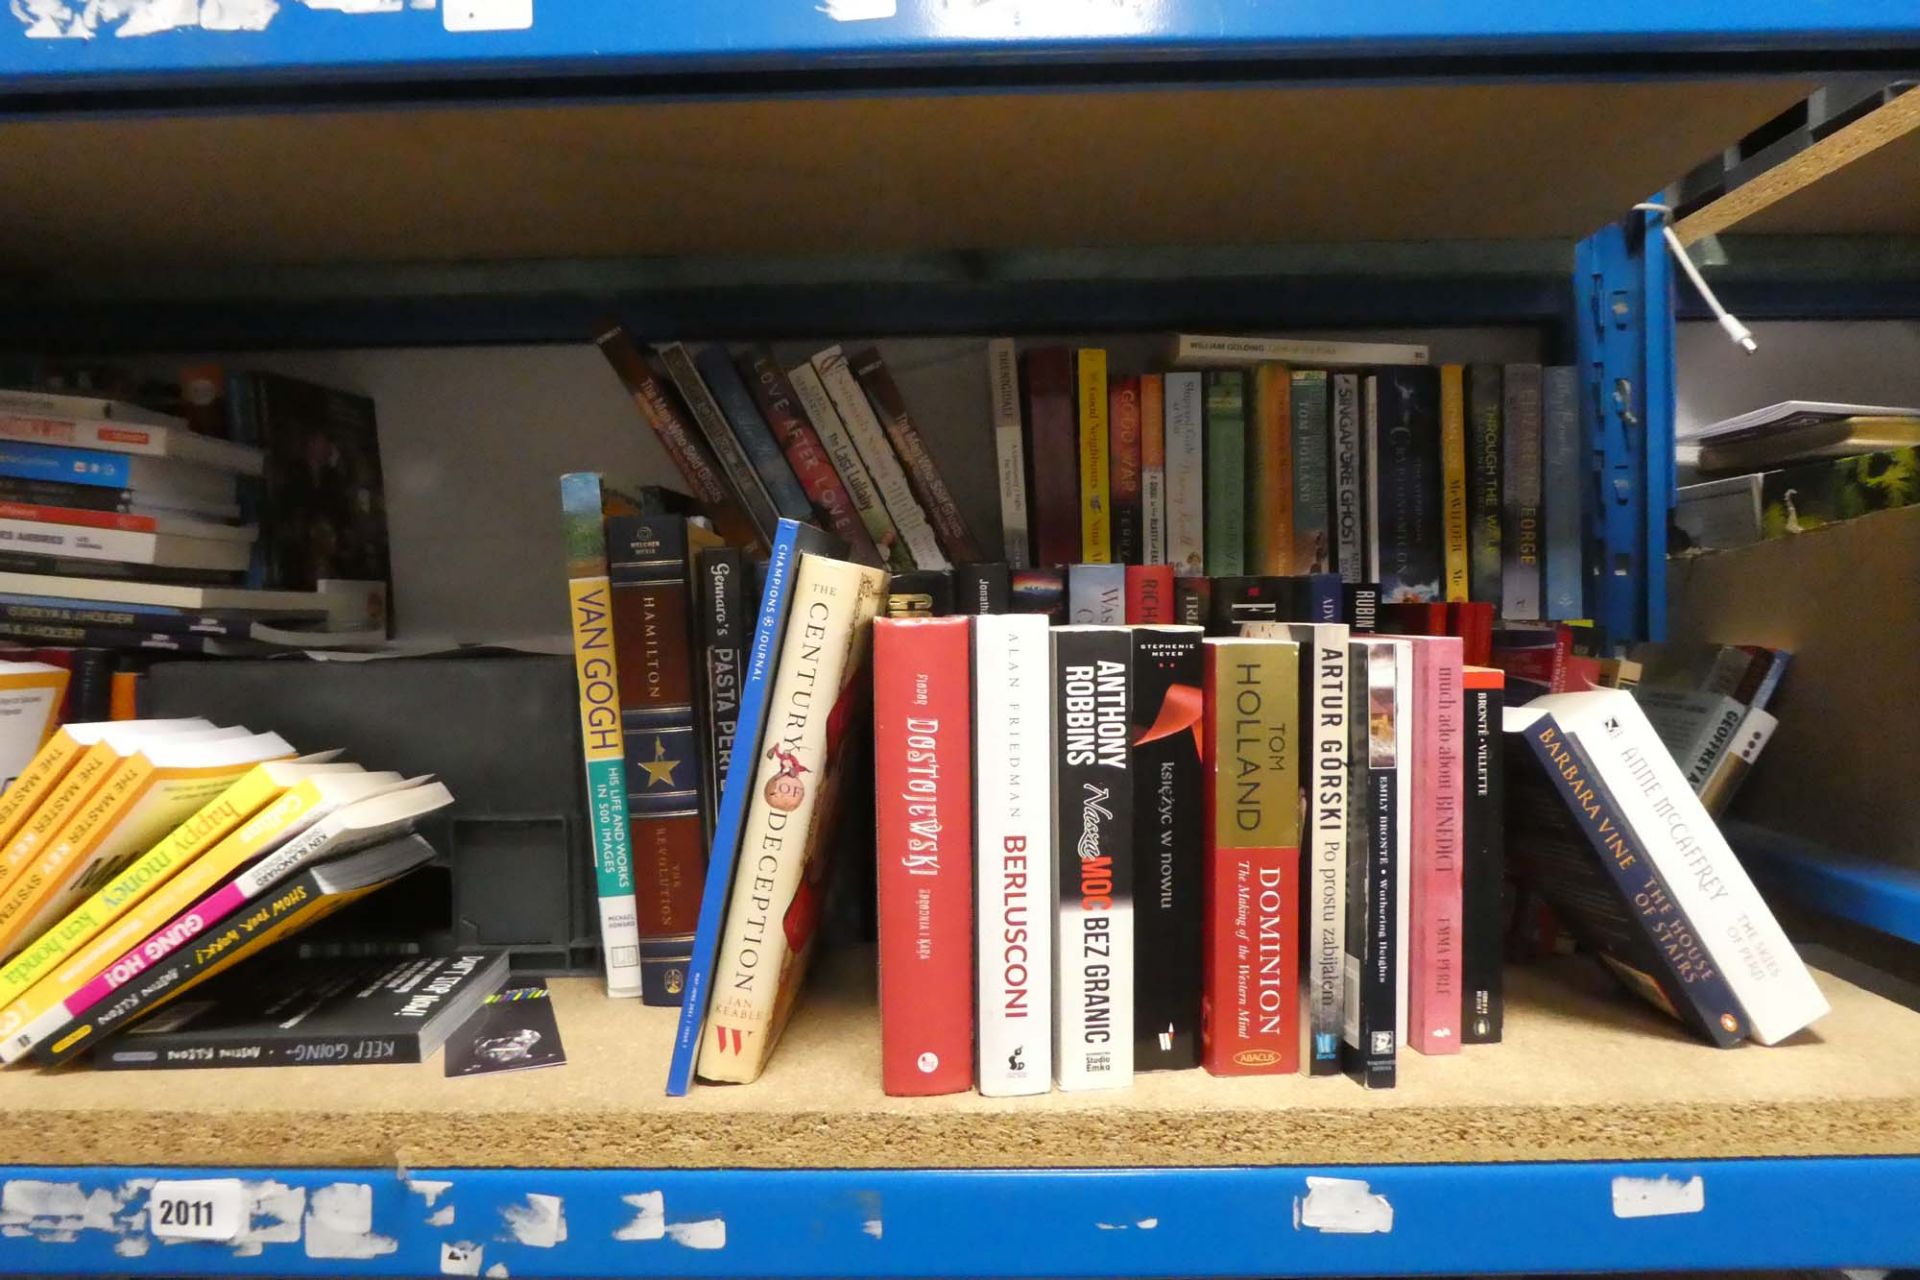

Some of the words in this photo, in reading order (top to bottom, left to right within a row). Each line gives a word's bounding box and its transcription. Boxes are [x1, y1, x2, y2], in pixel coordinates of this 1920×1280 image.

[753, 357, 789, 411] LOVE
[781, 418, 815, 470] AFTER
[813, 475, 849, 530] LOVE
[1484, 403, 1496, 475] THROUGH
[1486, 480, 1497, 506] THE
[1341, 489, 1355, 547] GHOST
[1520, 495, 1536, 566] GEORGE
[710, 562, 731, 635] Gennaro's
[768, 543, 788, 613] CHAMPIONS
[811, 583, 838, 597] THE
[577, 588, 609, 650] VAN
[643, 596, 662, 698] HAMILTON
[752, 630, 770, 682] JOURNAL
[1008, 633, 1020, 688] ALAN
[714, 648, 736, 712] PASTA
[783, 602, 829, 751] CENTURY
[1320, 647, 1344, 727] ARTUR
[1437, 666, 1456, 709] much
[583, 658, 621, 752] GOGH
[1065, 666, 1096, 766] ROBBINS
[1097, 660, 1127, 769] ANTHONY
[1437, 713, 1456, 743] ado
[40, 748, 64, 772] THE
[1008, 703, 1021, 818] FRIEDMAN
[1236, 663, 1261, 832] HOLLAND
[1268, 722, 1286, 771] TOM
[1436, 746, 1455, 789] about
[1696, 710, 1739, 776] GEOFFREY
[78, 756, 104, 782] THE
[113, 768, 138, 793] THE
[597, 784, 608, 799] IN
[607, 767, 620, 788] HIS
[779, 782, 804, 798] OF
[1319, 739, 1349, 831] GÓRSKI
[1477, 744, 1488, 797] VILLETTE
[33, 784, 81, 834] MASTER
[599, 802, 611, 823] 500
[609, 789, 622, 812] LIFE
[1378, 776, 1389, 812] EMILY
[1538, 726, 1603, 820] BARBARA
[1598, 818, 1637, 871] VINE
[68, 794, 116, 844] MASTER
[174, 799, 243, 857] happy
[307, 833, 329, 850] KEN
[611, 814, 625, 840] AND
[1434, 794, 1453, 873] BENEDICT
[254, 845, 309, 888] BLANCHARD
[601, 827, 616, 874] IMAGES
[615, 838, 630, 888] WORKS
[1238, 860, 1250, 881] The
[1324, 841, 1340, 862] Po
[102, 850, 174, 909] money
[271, 885, 310, 918] SHOW
[735, 811, 788, 992] DECEPTION
[1080, 856, 1113, 911] MOC
[1159, 852, 1173, 909] nowiu
[1235, 883, 1250, 924] Making
[1319, 868, 1338, 921] prostu
[62, 911, 98, 942] ken
[238, 907, 271, 934] YOUR
[1003, 835, 1028, 1019] BERLUSCONI
[1377, 878, 1388, 938] Wuthering
[1643, 879, 1675, 915] THE
[1669, 919, 1715, 982] HOUSE
[144, 913, 205, 960] GUNG
[195, 928, 242, 966] WORK!
[1083, 917, 1110, 958] BEZ
[1235, 925, 1250, 942] of
[1238, 944, 1250, 961] the
[1259, 867, 1281, 1035] DOMINION
[1437, 918, 1450, 954] EMMA
[1634, 892, 1657, 917] OF
[1652, 921, 1699, 984] STAIRS
[4, 938, 65, 986] honda
[103, 956, 147, 989] HO!
[1238, 962, 1250, 1011] Western
[1377, 941, 1388, 984] Heights
[97, 993, 140, 1026] KLEON
[1084, 964, 1111, 1044] GRANIC
[1238, 1012, 1250, 1040] Mind
[167, 1046, 214, 1060] KLEON
[354, 1040, 395, 1058] KEEP
[1240, 1053, 1275, 1062] ABACUS
[160, 1199, 214, 1227] 2011
